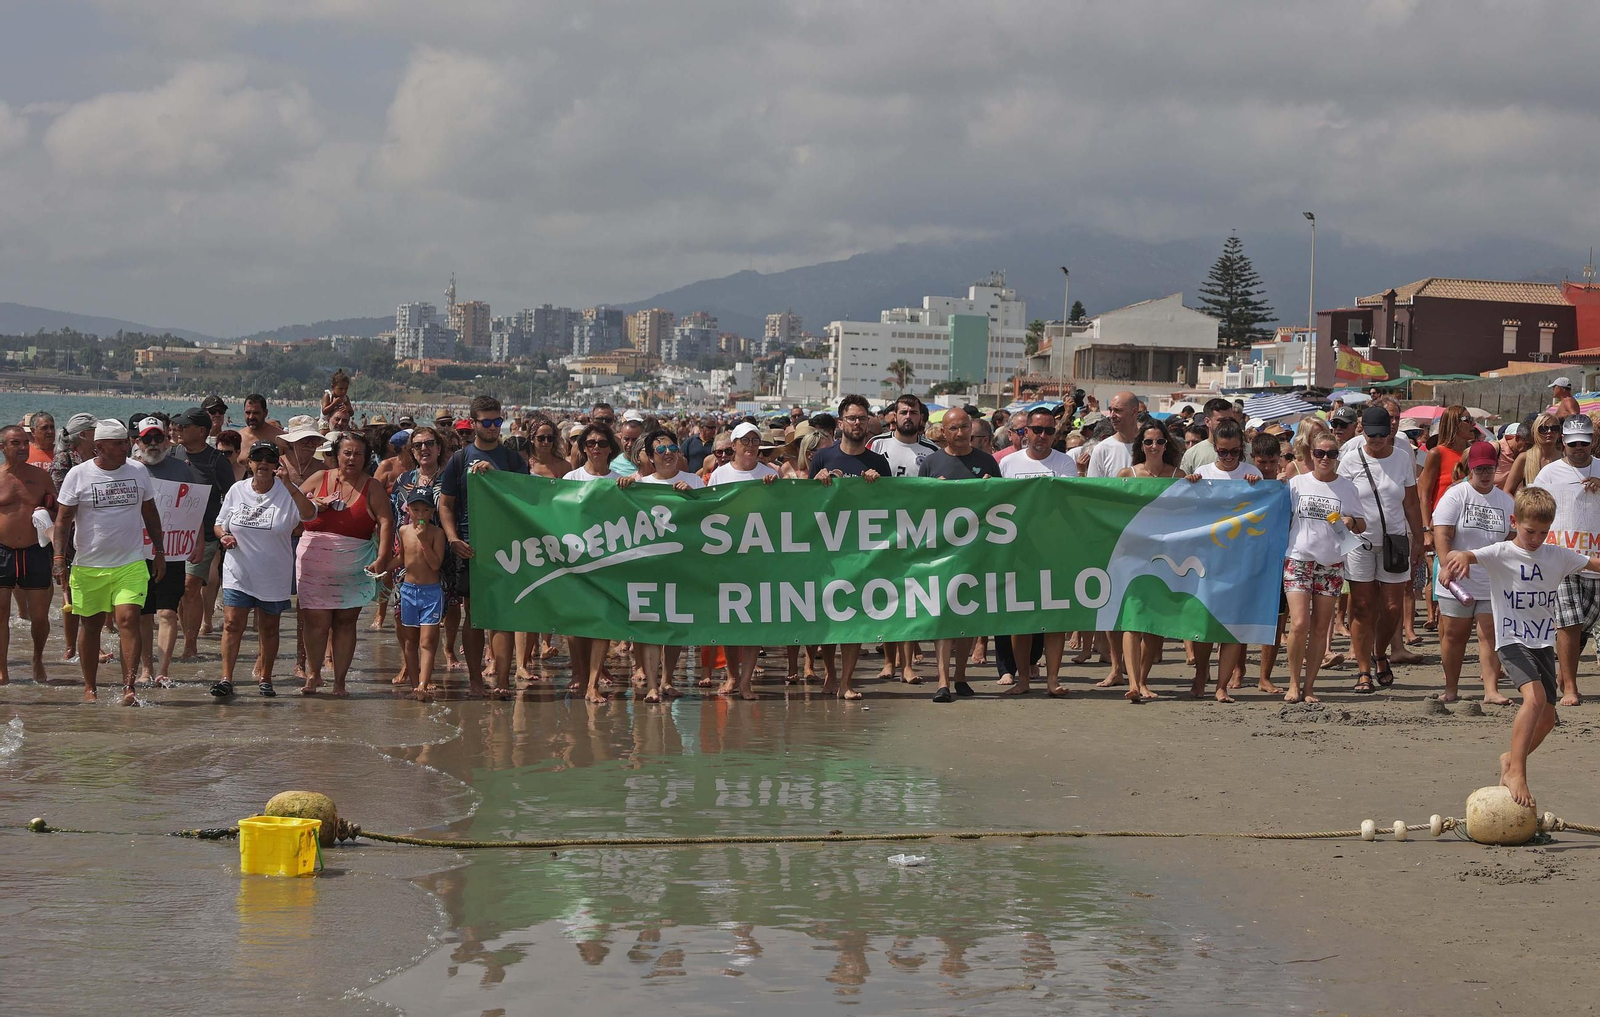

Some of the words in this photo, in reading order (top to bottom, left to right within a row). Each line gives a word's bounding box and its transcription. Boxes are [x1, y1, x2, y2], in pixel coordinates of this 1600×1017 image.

[1570, 420, 1584, 430] NY
[106, 486, 137, 496] RINCONCILLO
[495, 505, 677, 574] VERDEMAR
[700, 504, 1018, 555] SALVEMOS
[1546, 530, 1600, 550] ALVEM
[1520, 564, 1544, 581] LA
[627, 582, 694, 624] EL
[718, 567, 1112, 624] RINCONCILLO
[1504, 590, 1557, 610] MEJOR
[1502, 617, 1555, 640] PLAYA
